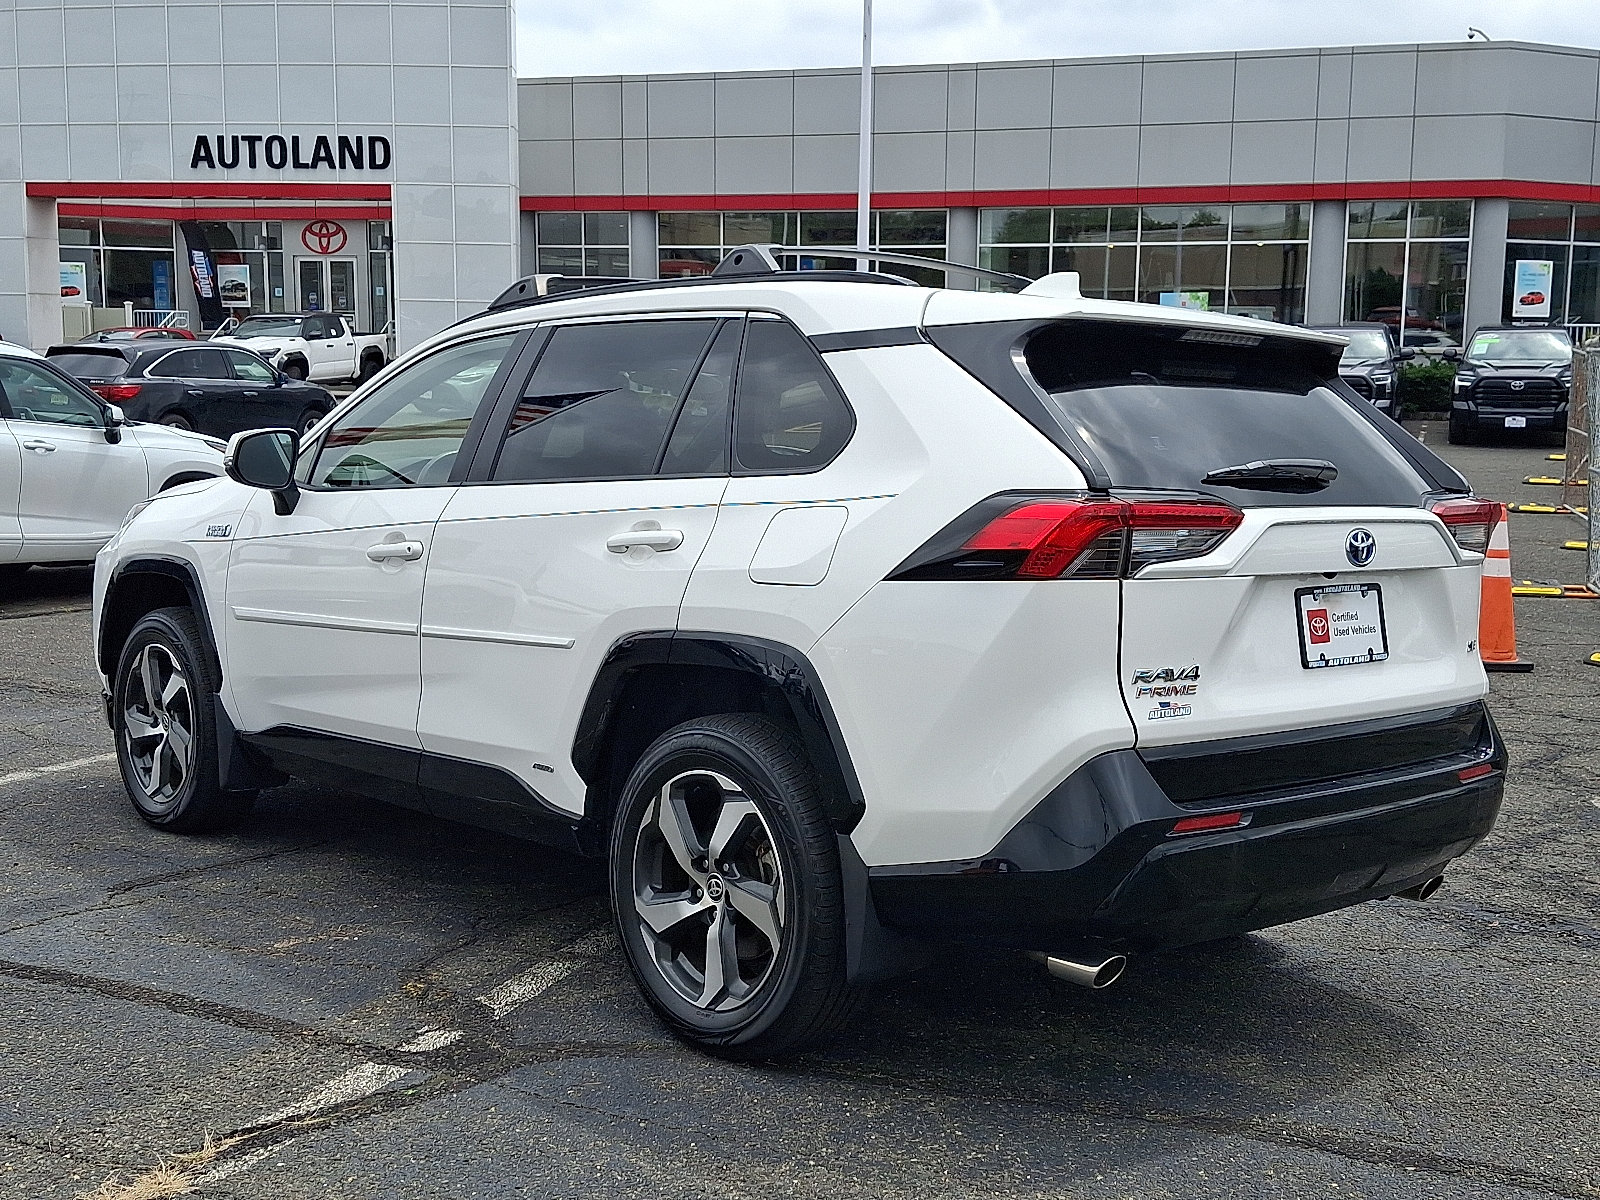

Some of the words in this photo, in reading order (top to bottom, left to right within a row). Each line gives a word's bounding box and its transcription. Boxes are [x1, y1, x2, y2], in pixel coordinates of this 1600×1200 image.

[190, 134, 391, 170] AUTOLAND
[191, 249, 213, 298] AUTOLAND
[1331, 611, 1359, 622] Certified
[1333, 626, 1350, 637] Used
[1350, 624, 1377, 636] Vehicles
[1328, 655, 1370, 667] AUTOLAND
[1131, 664, 1201, 685] RAV4
[1135, 684, 1198, 699] PRIME
[1148, 706, 1192, 720] AUTOLAND
